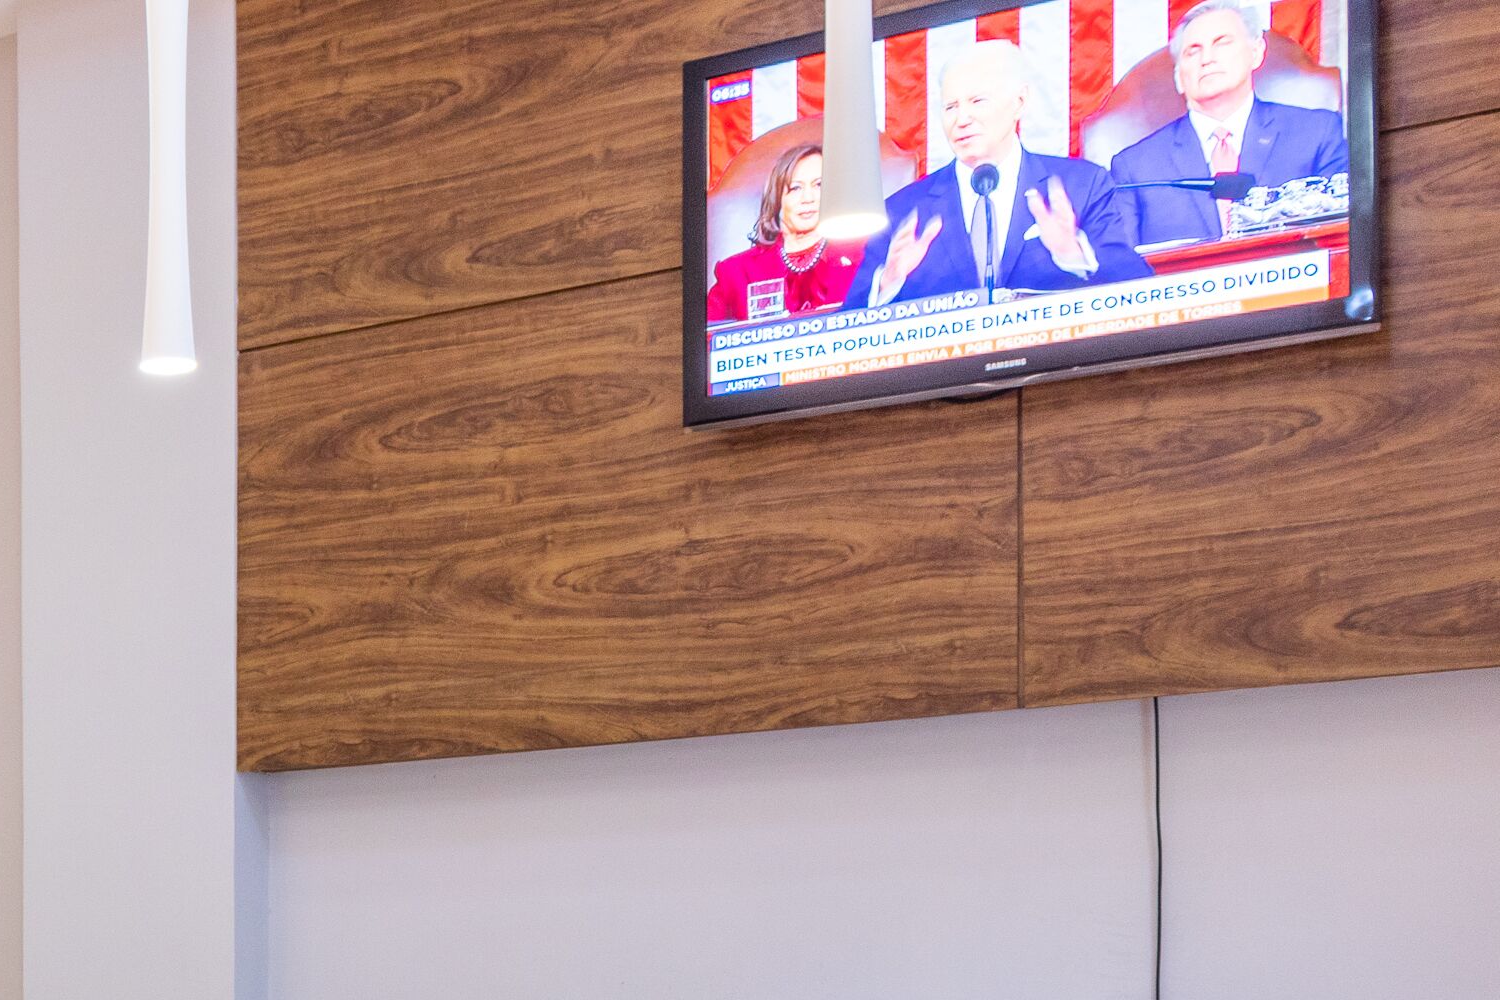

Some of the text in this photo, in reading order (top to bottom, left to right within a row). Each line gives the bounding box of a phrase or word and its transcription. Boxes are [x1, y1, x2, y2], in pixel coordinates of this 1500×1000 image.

[715, 290, 980, 350] DISCURSO DO ESTADO DA UNIÃO
[716, 263, 1319, 373] BIDEN TESTA POPULARIDADE DIANTE DE CONGRESSO DIVIDIDO
[785, 364, 847, 383] MINISTRO
[849, 356, 904, 374] MORAES
[907, 348, 948, 363] ENVIA
[995, 332, 1049, 350] PEDIDO
[1051, 328, 1072, 342] DE
[1074, 314, 1155, 337] LIBERDADE
[1157, 310, 1180, 325] DE
[724, 378, 767, 393] JUSTIÇA
[984, 357, 1027, 371] SAMSUNG
